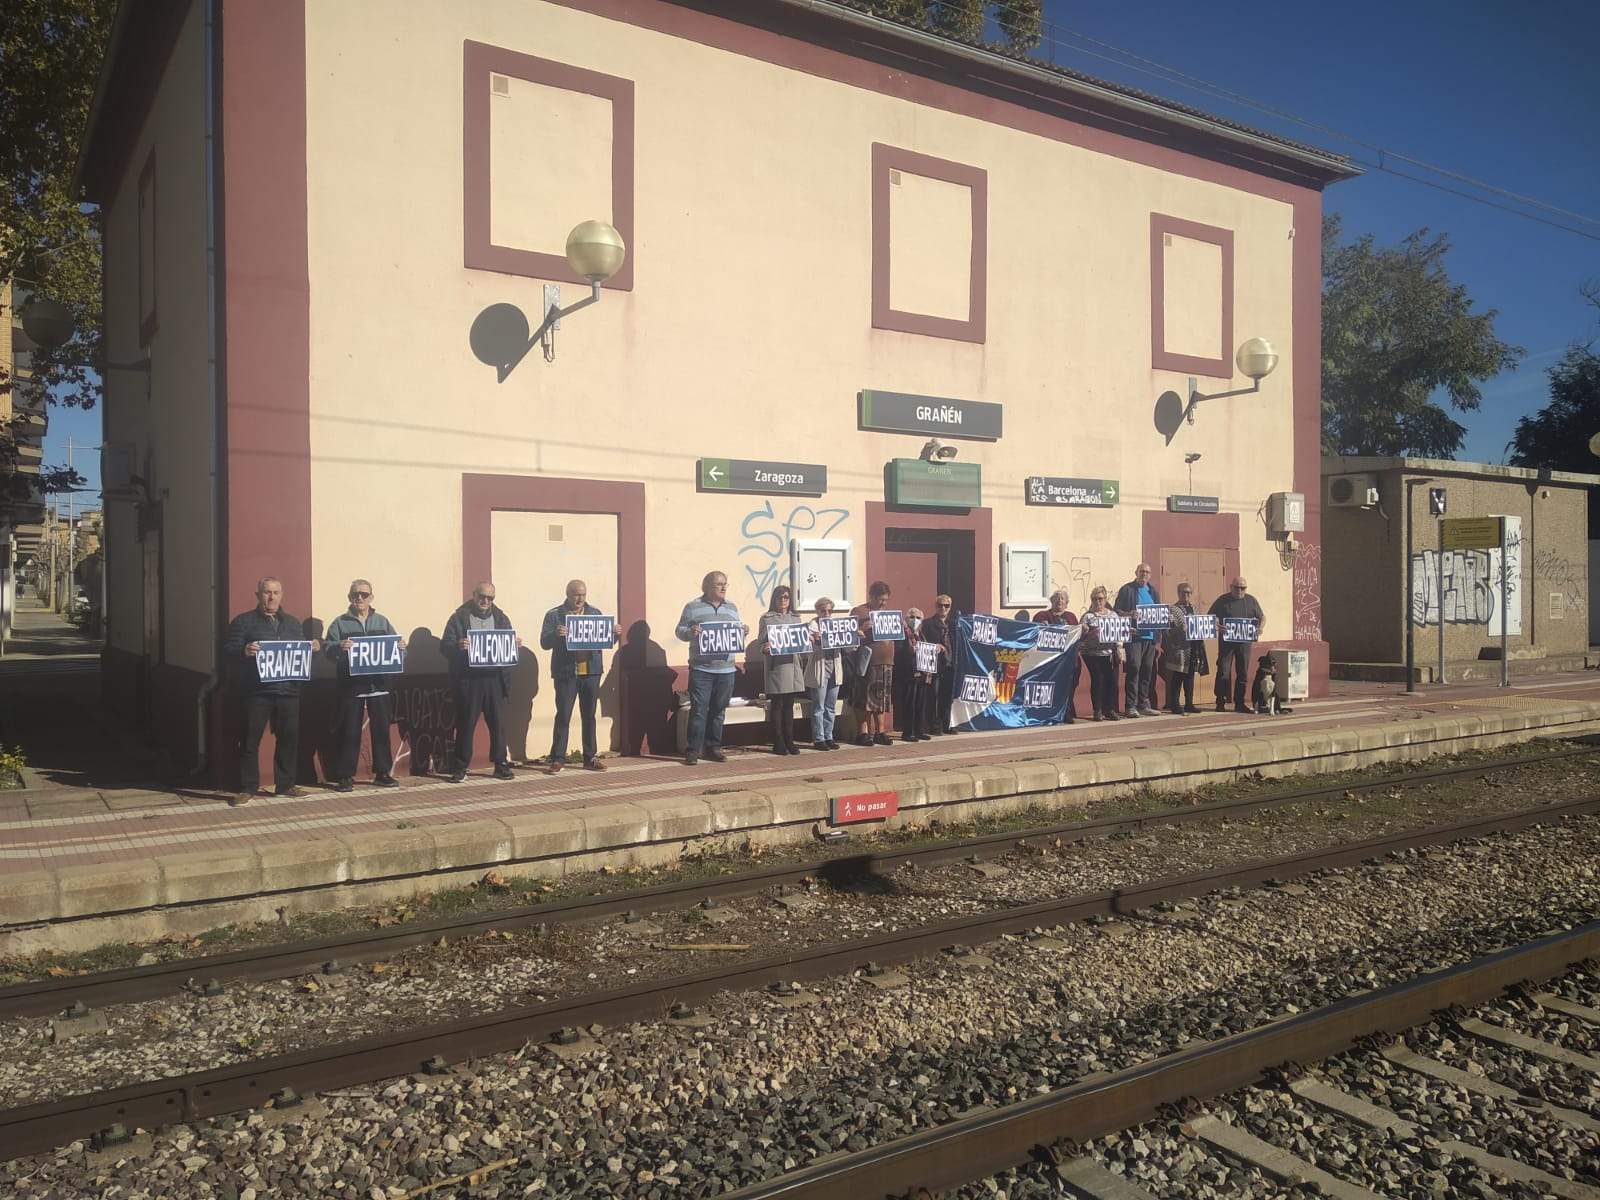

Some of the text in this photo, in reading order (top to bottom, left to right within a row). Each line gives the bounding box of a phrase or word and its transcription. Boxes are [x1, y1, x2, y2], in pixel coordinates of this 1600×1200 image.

[916, 405, 962, 425] GRAÑÉN
[754, 470, 804, 485] Zaragoza
[1048, 485, 1087, 497] Barcelona
[822, 619, 857, 634] ALBERO
[874, 614, 902, 635] ROBRES
[1138, 608, 1169, 624] BARBUES
[568, 620, 612, 641] ALBERUELA
[701, 622, 744, 652] GRAÑÉN
[769, 626, 810, 649] SODETO
[1099, 618, 1130, 642] ROBRES
[1188, 616, 1215, 639] CURBE
[469, 636, 518, 663] VALFONDA
[829, 633, 852, 646] BAJO
[257, 643, 311, 678] GRAÑÉN
[350, 641, 401, 666] FRULA
[961, 678, 987, 701] TRENES
[868, 803, 887, 812] pasar
